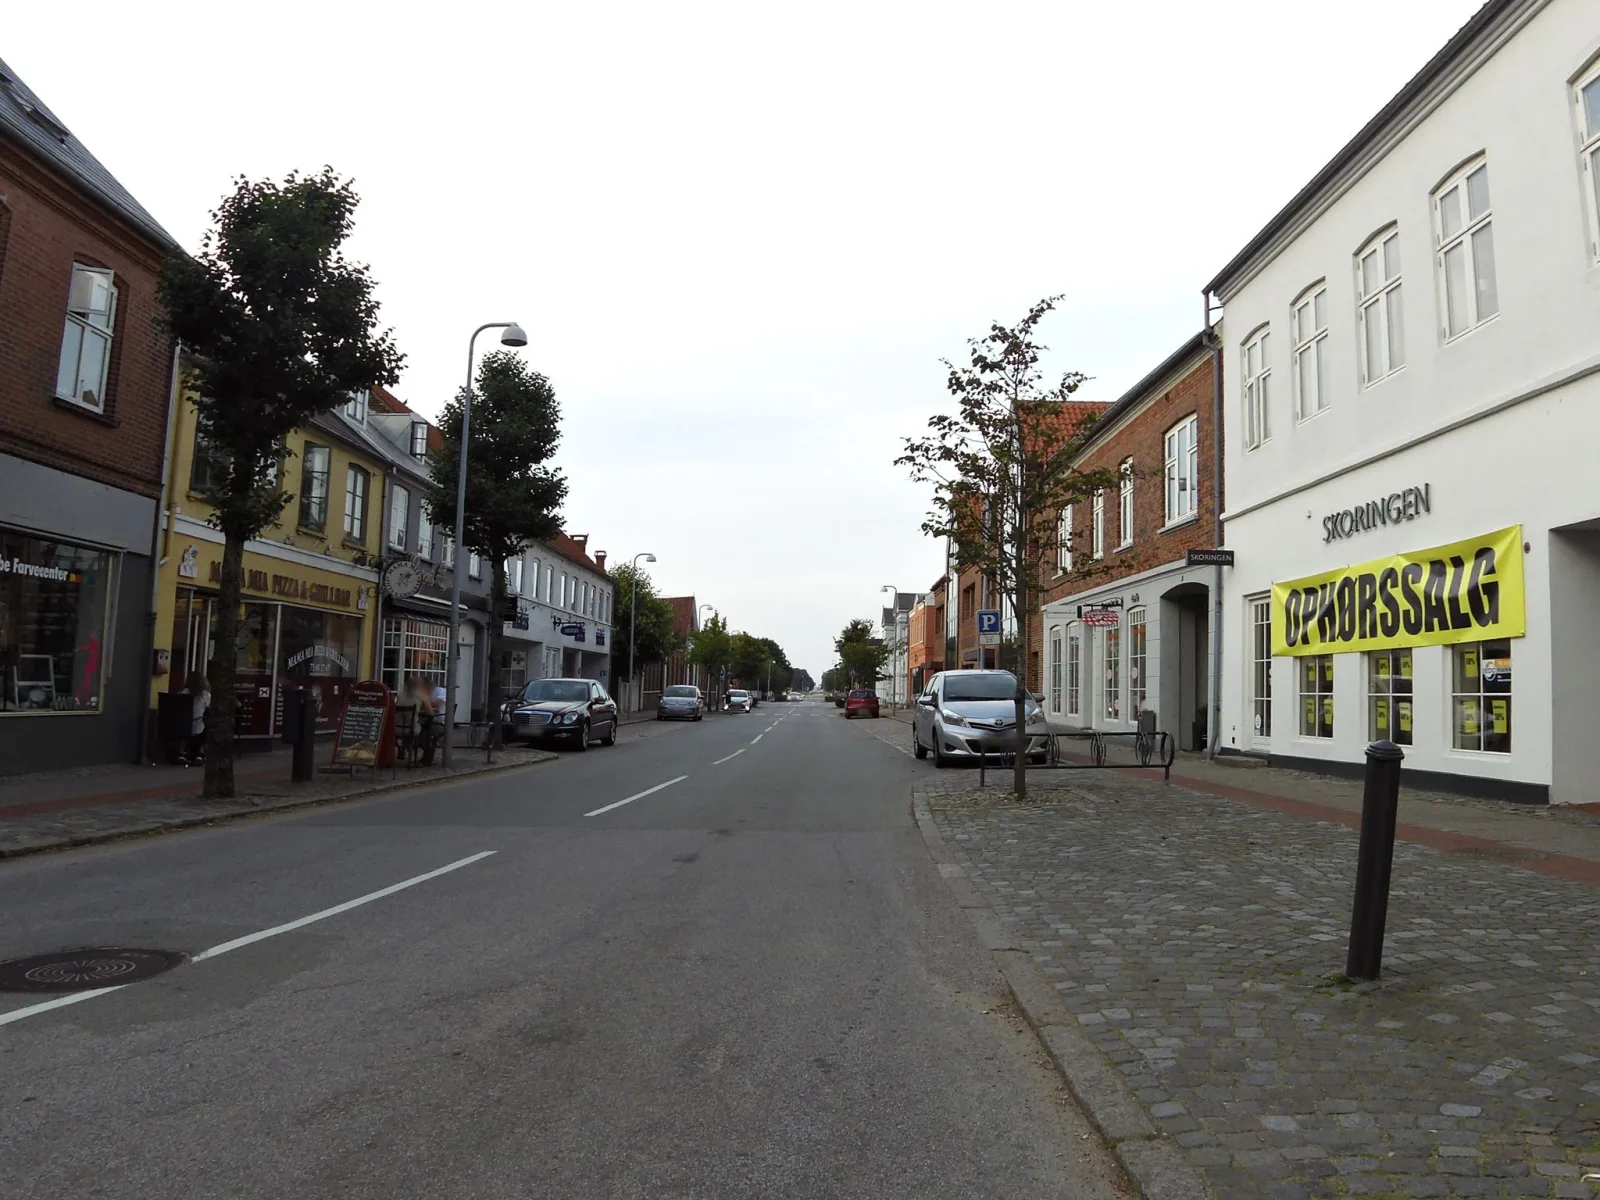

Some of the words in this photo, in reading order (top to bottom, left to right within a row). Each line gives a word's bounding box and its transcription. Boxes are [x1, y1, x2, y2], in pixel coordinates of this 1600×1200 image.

[1322, 482, 1431, 544] SKORINGEN
[12, 557, 69, 581] Farvecenter
[1190, 553, 1232, 561] SKORINGEN
[247, 569, 269, 592] MIA
[271, 574, 300, 598] PIZZA
[309, 583, 351, 607] GRILLBAR
[1285, 546, 1499, 647] OPHØRSSALG
[981, 614, 996, 631] P
[287, 650, 305, 670] MAMA
